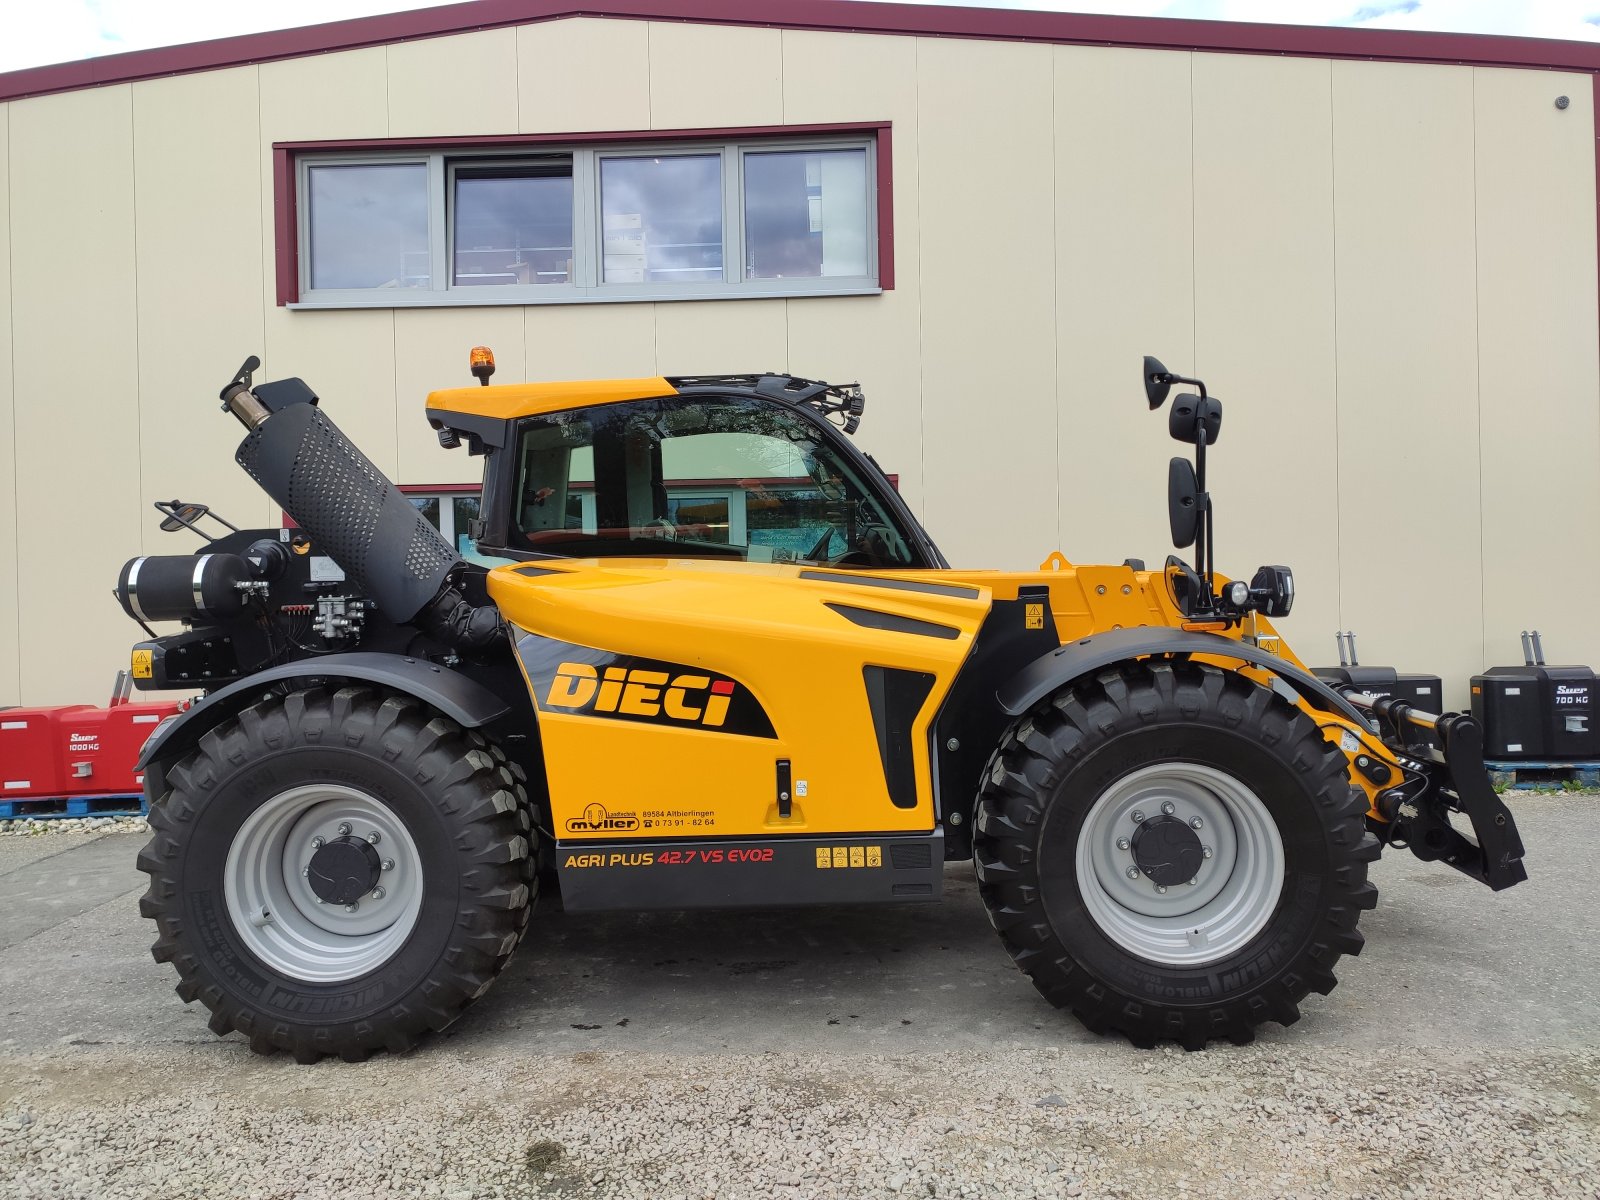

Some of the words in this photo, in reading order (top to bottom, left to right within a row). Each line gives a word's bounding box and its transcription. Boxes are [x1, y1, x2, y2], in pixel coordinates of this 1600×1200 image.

[1556, 685, 1588, 695] Suer
[1555, 696, 1573, 704] 700
[1575, 696, 1589, 704] KG
[70, 733, 98, 742] Suer
[69, 743, 88, 752] 1000
[88, 743, 100, 751] KG
[642, 810, 665, 818] 89584
[667, 809, 715, 819] Altbierlingen
[564, 854, 606, 868] AGRI
[609, 852, 654, 867] PLUS
[656, 850, 697, 864] 42.7
[699, 849, 724, 863] VS
[727, 848, 775, 863] EVO2
[268, 981, 385, 1014] MICHELIN
